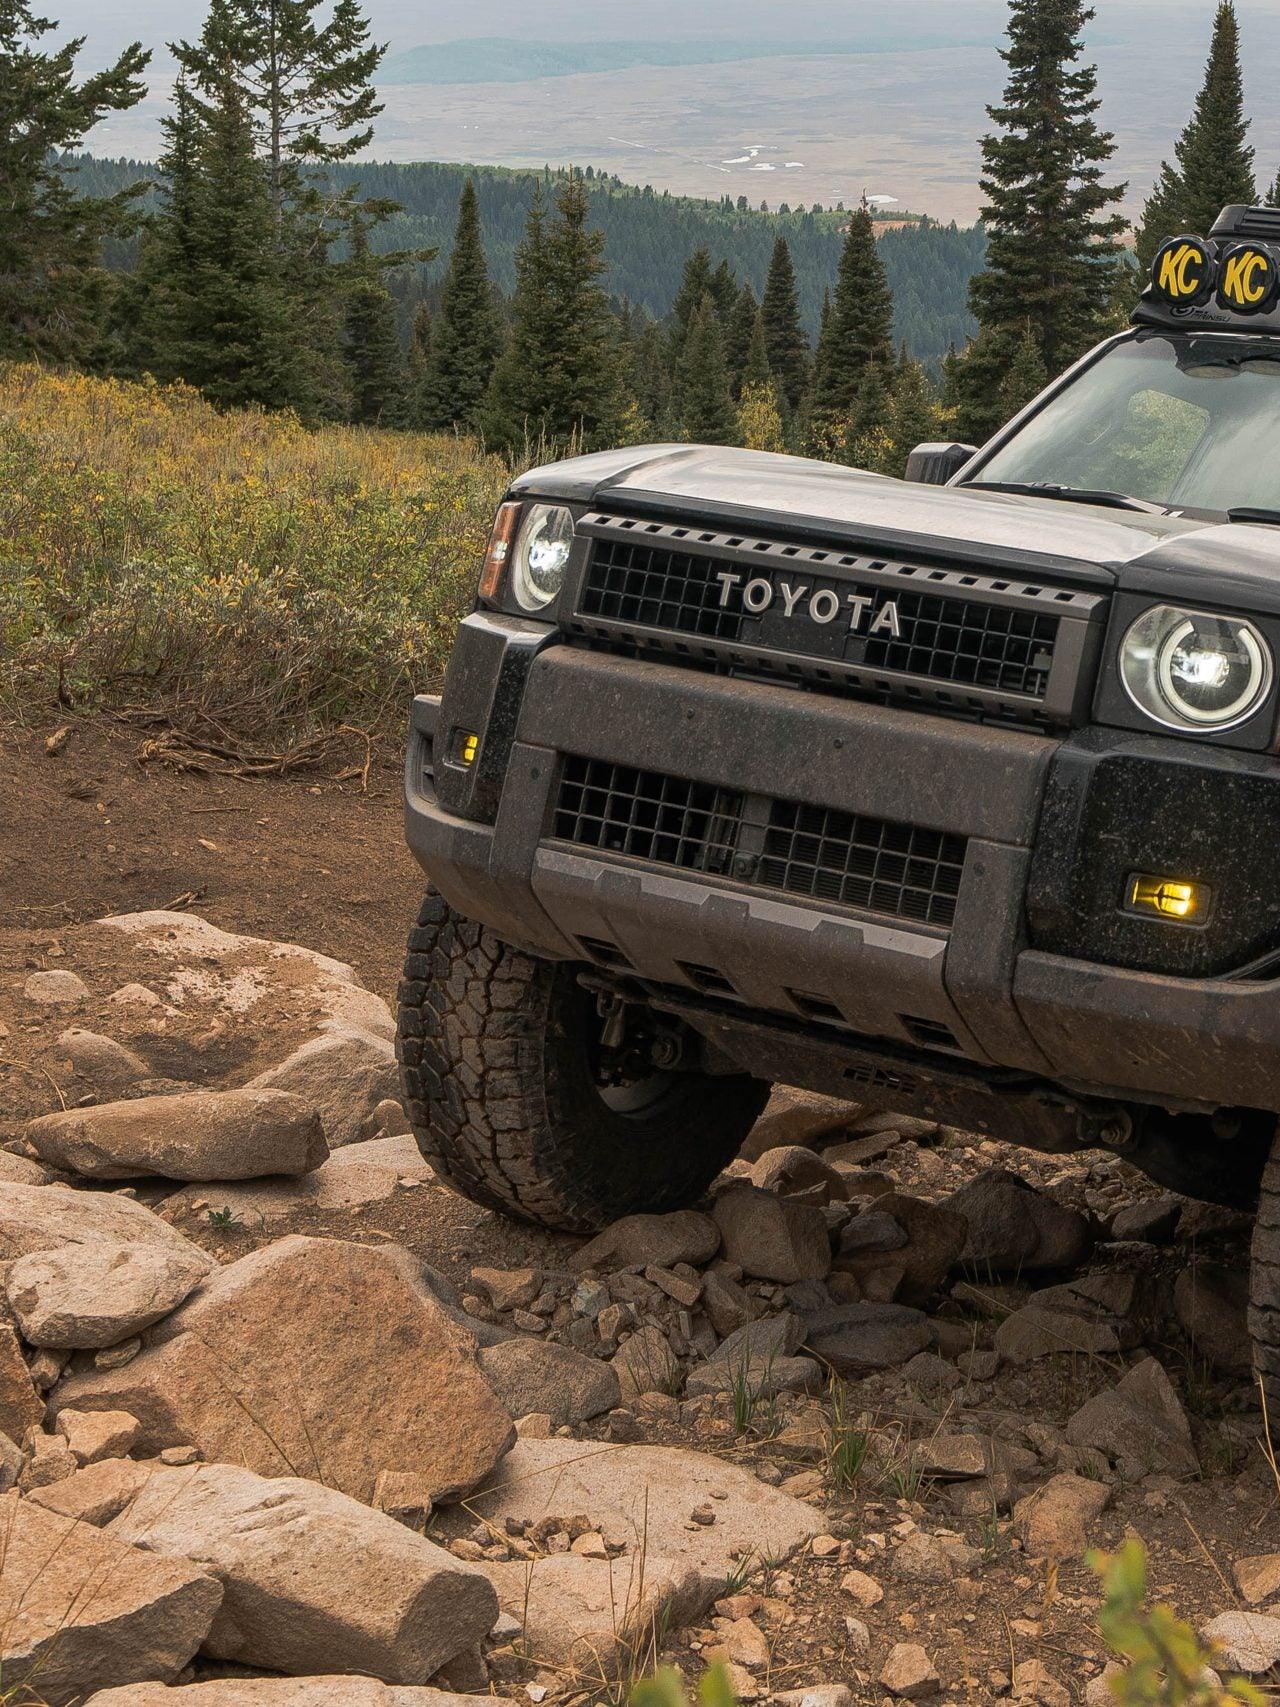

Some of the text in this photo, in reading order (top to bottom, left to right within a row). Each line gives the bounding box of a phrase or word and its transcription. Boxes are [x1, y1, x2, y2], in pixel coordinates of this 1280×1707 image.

[1159, 245, 1202, 296] KC
[1224, 252, 1268, 304] KC
[716, 572, 900, 637] TOYOTA
